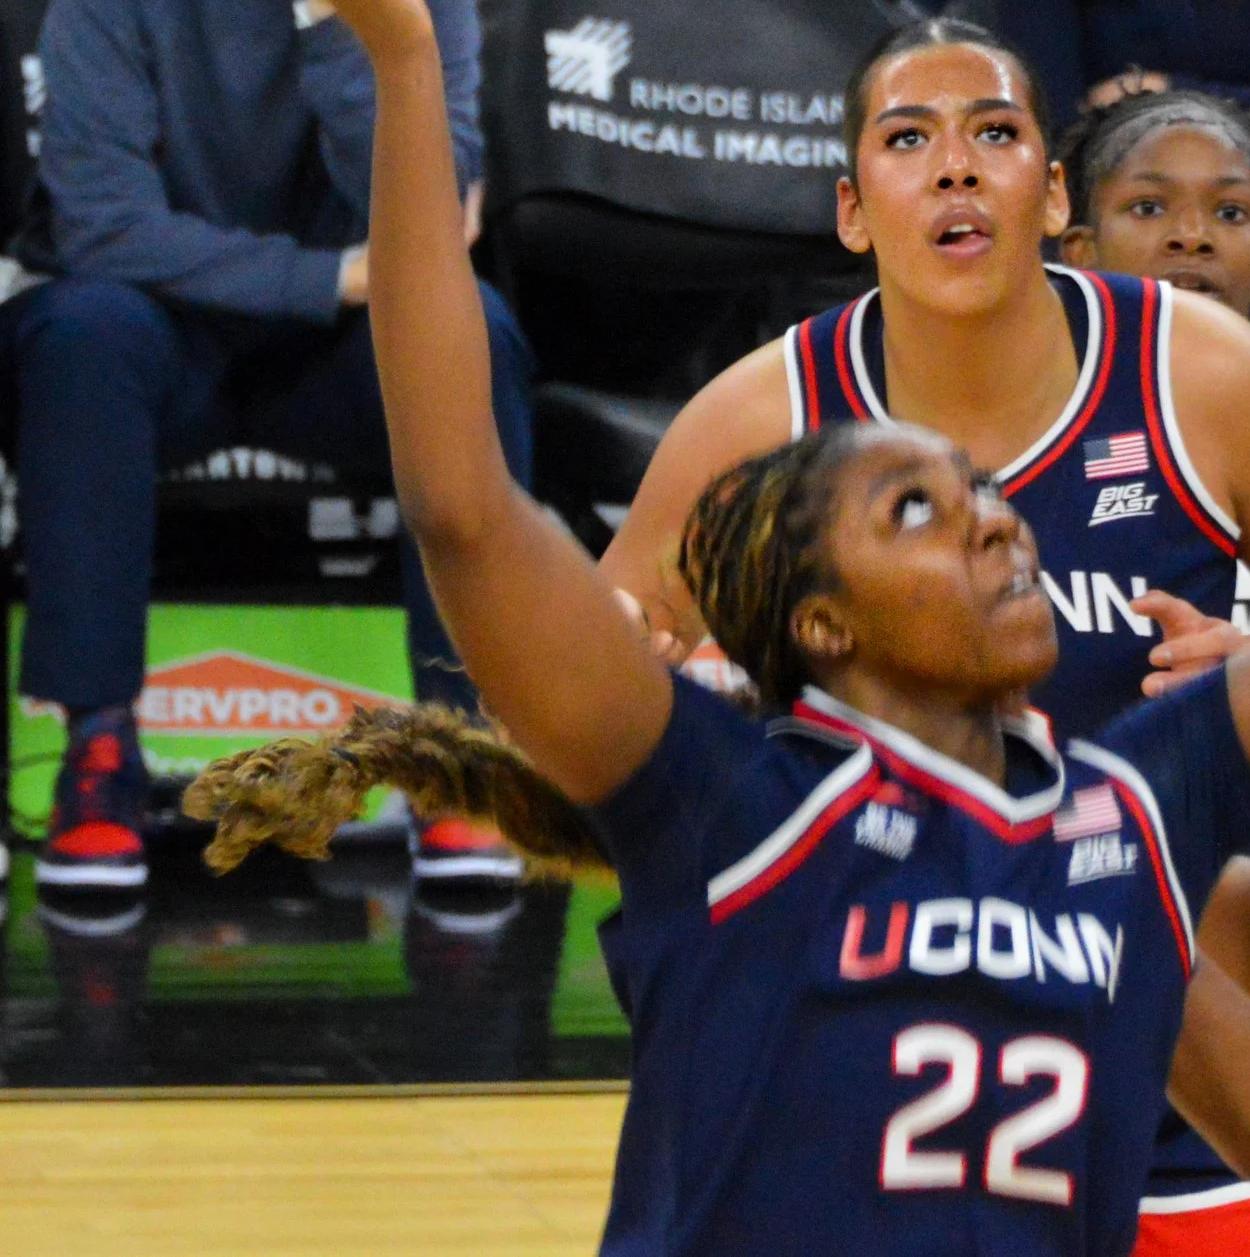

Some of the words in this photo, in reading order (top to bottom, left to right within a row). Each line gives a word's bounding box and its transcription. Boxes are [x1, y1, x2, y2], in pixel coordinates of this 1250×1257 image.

[629, 77, 752, 121] RHODE
[760, 93, 846, 126] ISLAN
[547, 103, 704, 158] MEDICAL
[714, 130, 849, 168] IMAGIN
[1091, 494, 1159, 519] EAST
[1097, 482, 1145, 503] BIG
[133, 685, 341, 726] ERVPRO
[840, 897, 1124, 1004] UCONN
[879, 1021, 1092, 1208] 22
